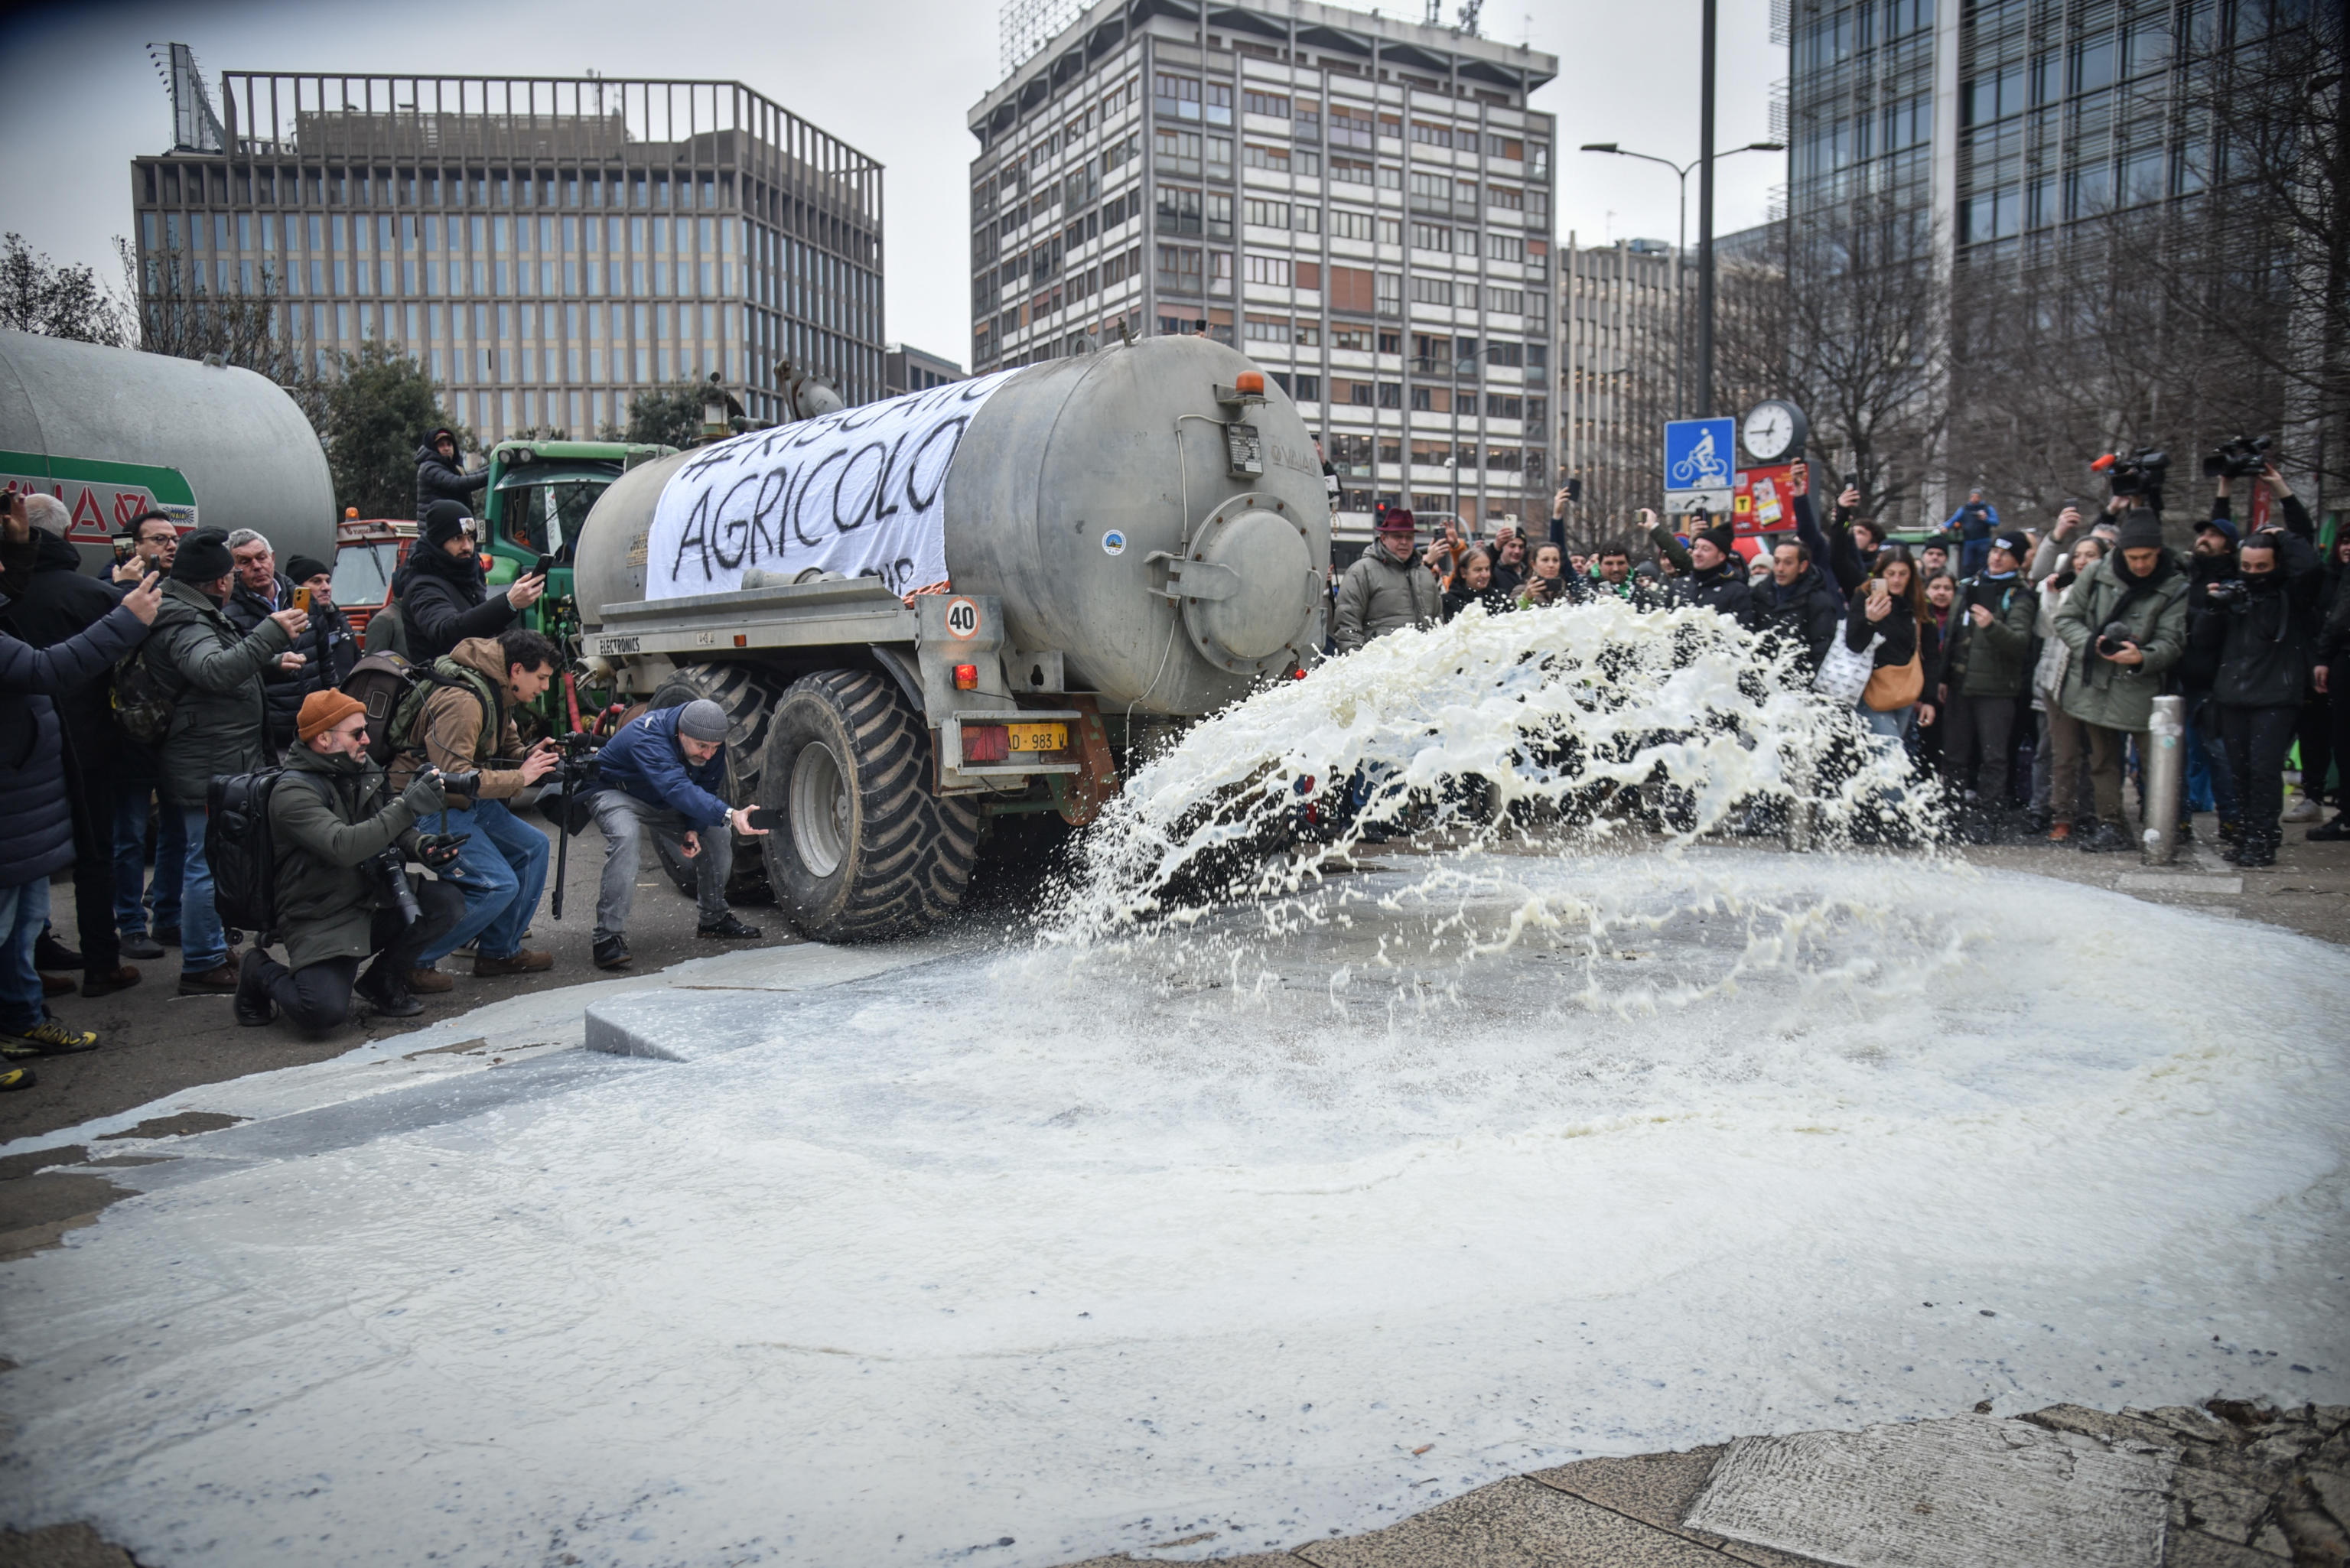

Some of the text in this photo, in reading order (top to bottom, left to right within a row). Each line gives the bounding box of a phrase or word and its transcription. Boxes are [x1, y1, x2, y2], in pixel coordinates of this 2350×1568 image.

[672, 415, 970, 582] AGRICOLO
[949, 606, 975, 629] 40
[600, 636, 640, 654] ELECTRONICS
[1032, 734, 1052, 749] 983
